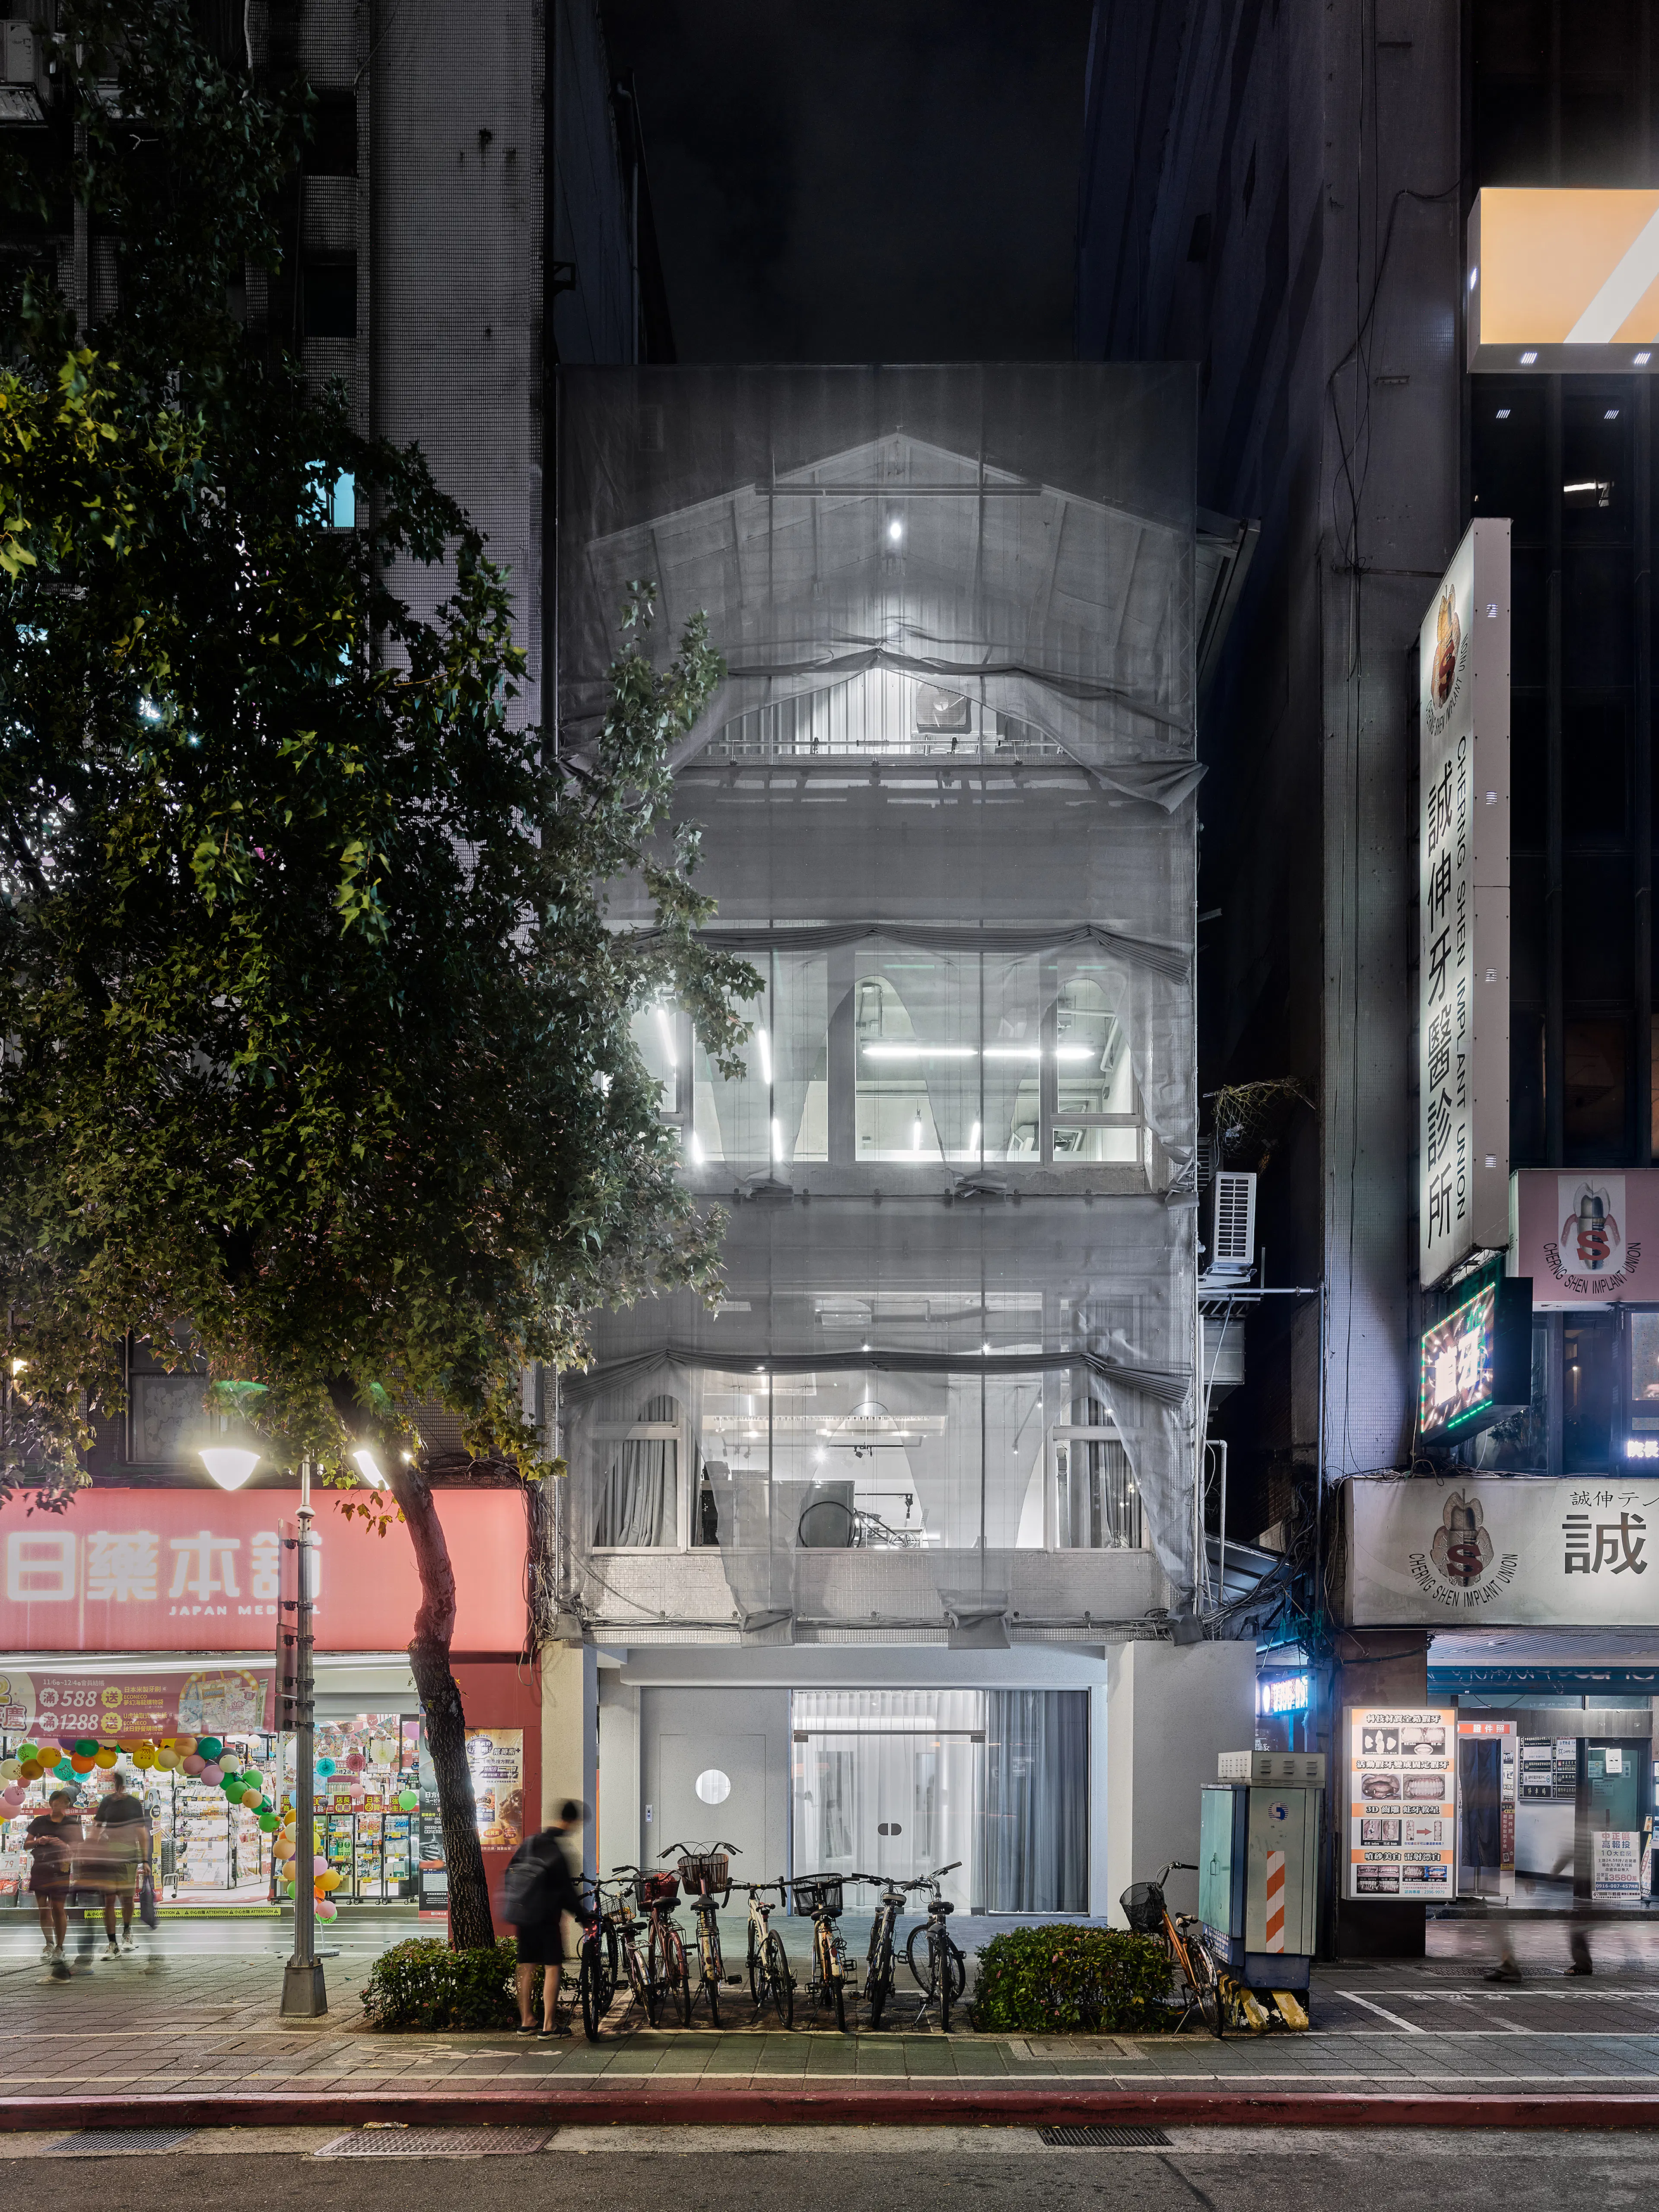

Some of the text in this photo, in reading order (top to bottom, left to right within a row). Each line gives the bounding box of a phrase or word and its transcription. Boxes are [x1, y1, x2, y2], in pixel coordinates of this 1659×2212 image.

[1446, 677, 1462, 724] IMPLANT
[1459, 633, 1468, 672] UNION
[1456, 735, 1466, 1220] CHERNG SHEN IMPLANT UNION
[1427, 760, 1453, 1250] 誠伸牙醫診所
[1543, 1242, 1641, 1294] CHERNG SHEN IMPLANT UNION
[1562, 1512, 1648, 1575] 誠
[1409, 1553, 1518, 1608] CHERNG SHEN IMPLANT UNION
[169, 1605, 321, 1615] JAPAN MEDL
[43, 1691, 97, 1707] 滿 588
[105, 1691, 118, 1703] 送
[0, 1707, 24, 1727] 慶
[60, 1714, 99, 1730] 1288
[105, 1716, 118, 1729] 送
[1473, 1724, 1504, 1733] 證件照
[1520, 1749, 1523, 1758] 4
[1520, 1762, 1523, 1770] 3
[1553, 1761, 1556, 1770] 9
[1520, 1774, 1523, 1783] 2
[1553, 1774, 1556, 1783] 8
[1527, 1787, 1546, 1795] 停車場
[1553, 1787, 1556, 1796] 7
[1366, 1805, 1379, 1814] 3D
[1602, 1832, 1630, 1840] 中正區
[1602, 1840, 1630, 1849] 高報投
[1404, 1852, 1441, 1862] 雷射漂白
